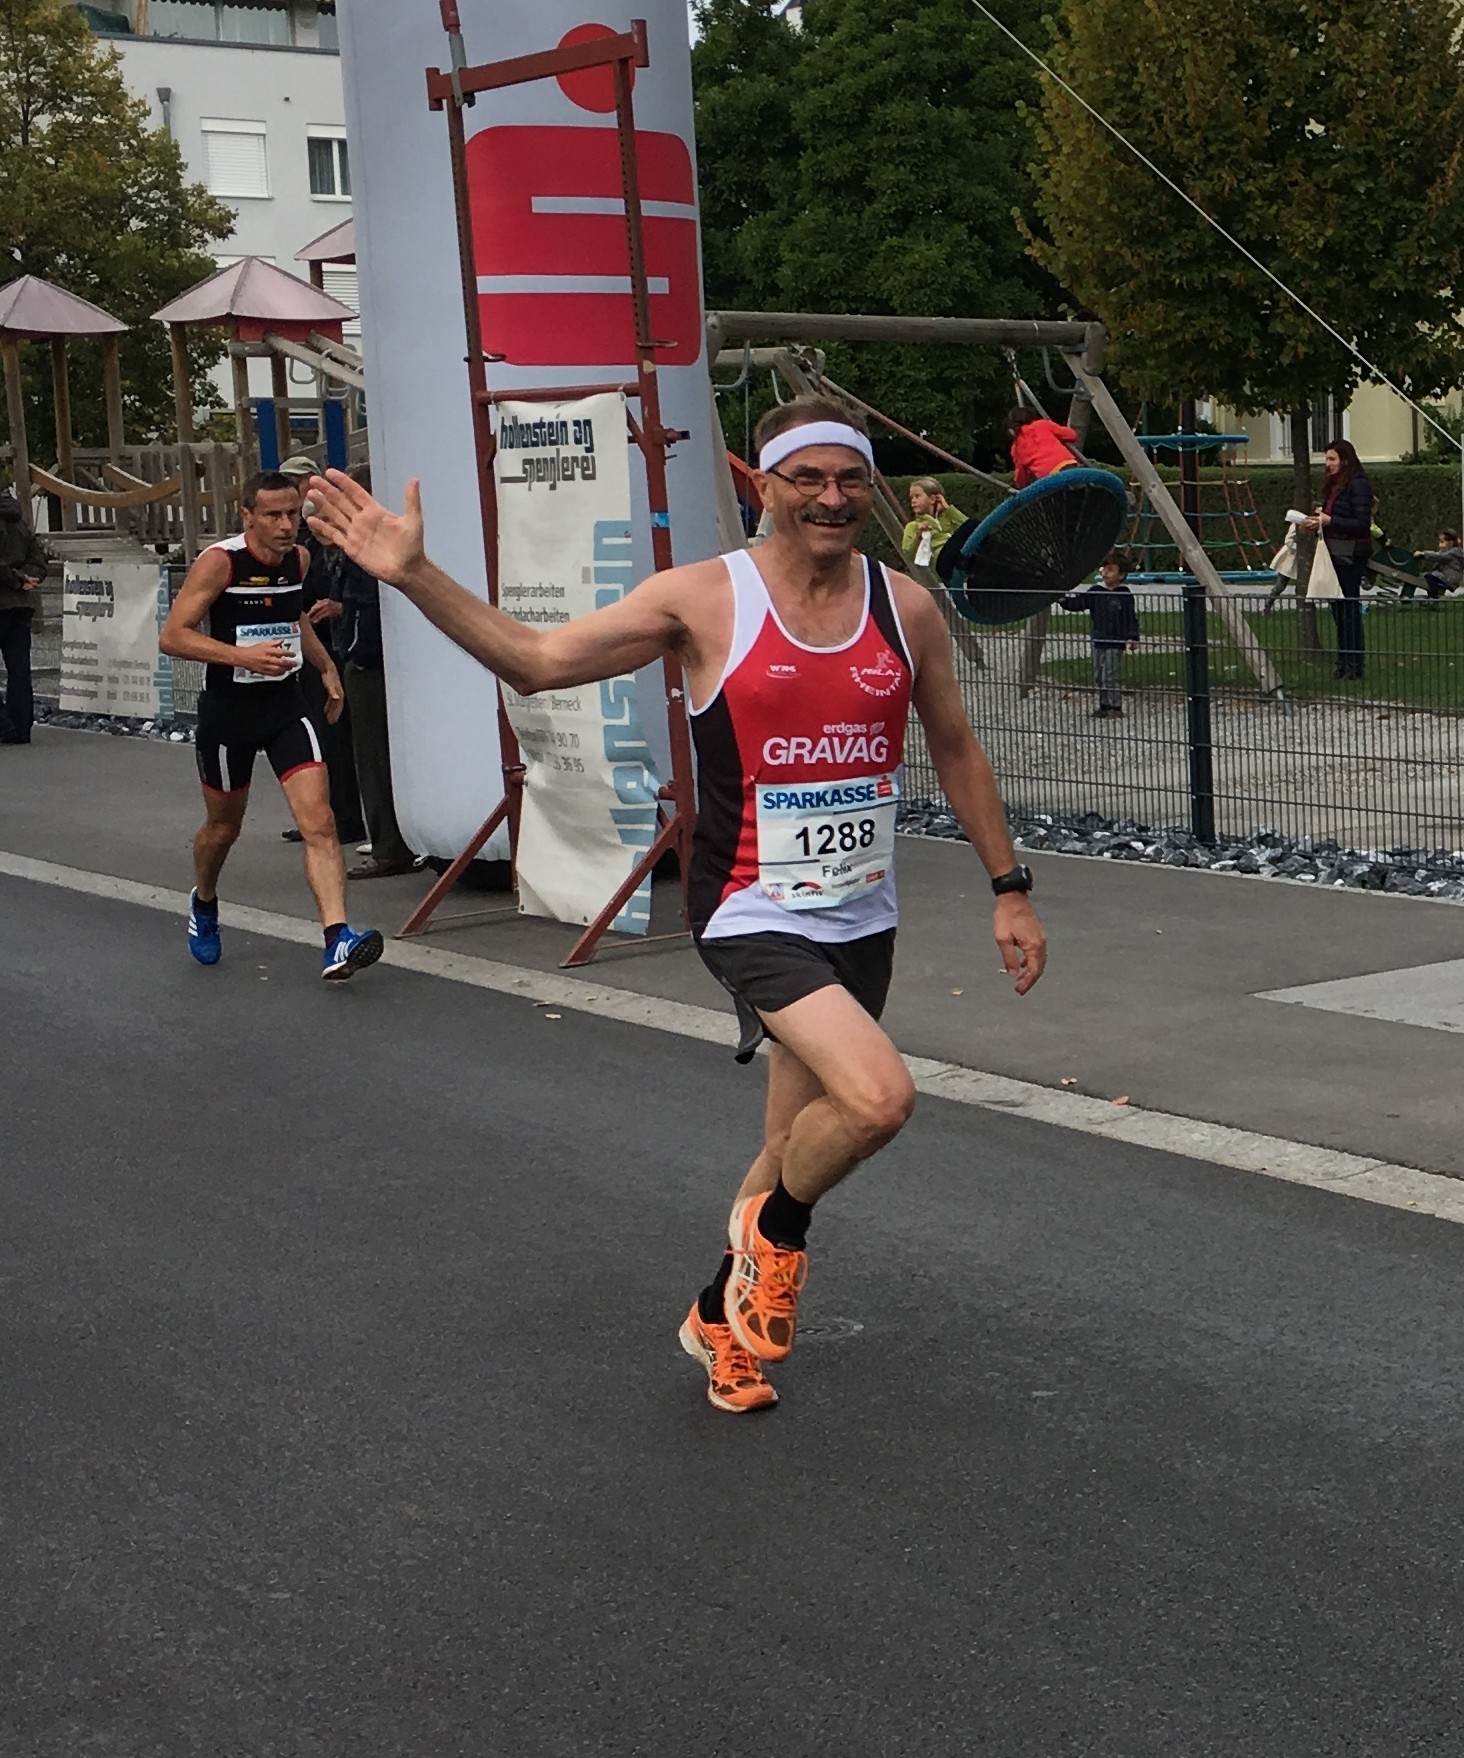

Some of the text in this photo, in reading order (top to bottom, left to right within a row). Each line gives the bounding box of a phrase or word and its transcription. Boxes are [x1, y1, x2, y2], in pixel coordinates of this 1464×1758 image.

[500, 413, 595, 453] hollenstein ag
[240, 626, 291, 637] SPARKASSE
[823, 722, 867, 736] erdgas
[762, 736, 889, 765] GRAVAG
[763, 784, 877, 809] SPARKASSE
[795, 819, 875, 856] 1288
[822, 862, 853, 878] Felix
